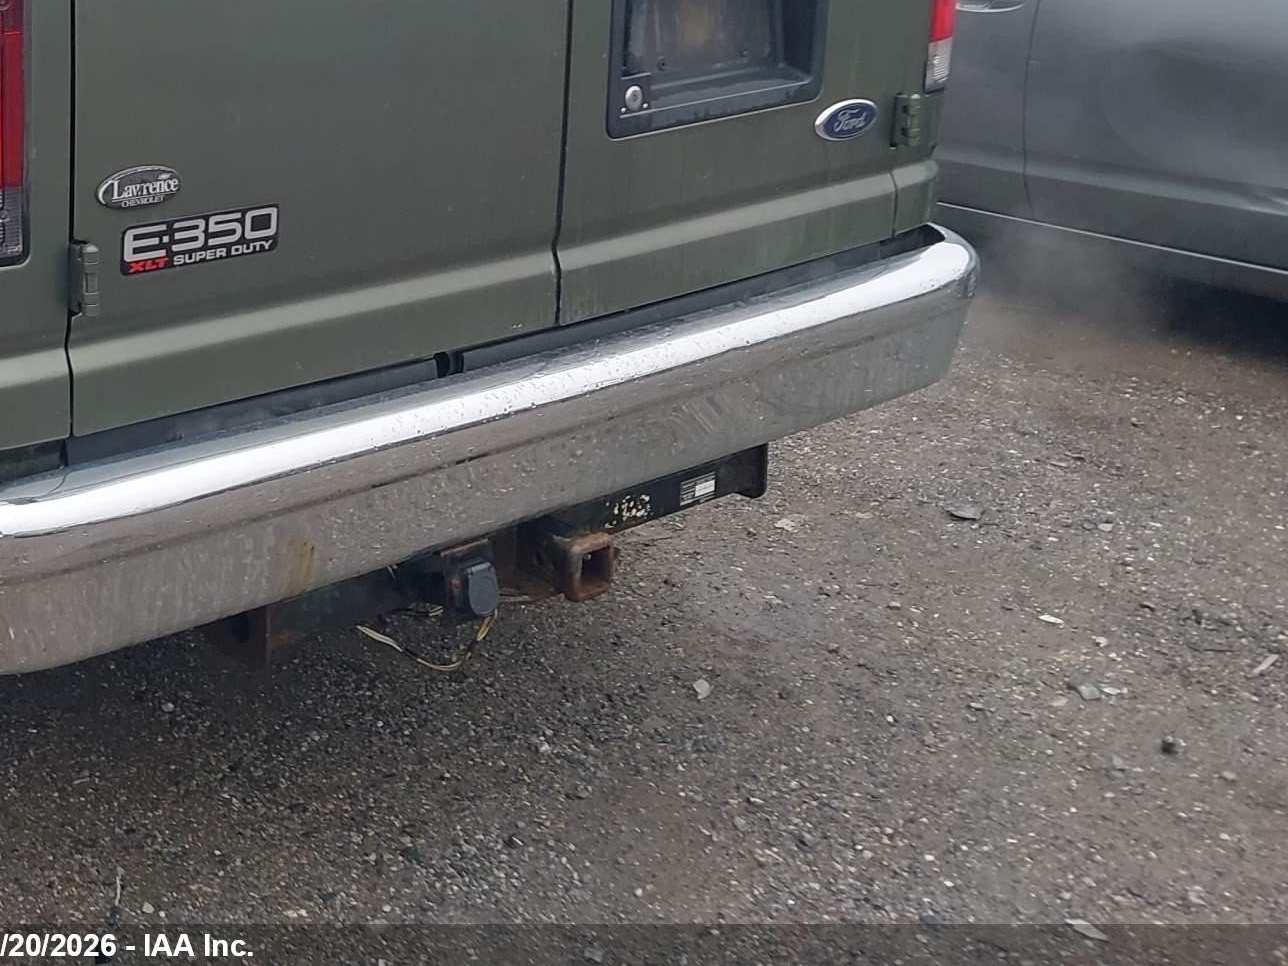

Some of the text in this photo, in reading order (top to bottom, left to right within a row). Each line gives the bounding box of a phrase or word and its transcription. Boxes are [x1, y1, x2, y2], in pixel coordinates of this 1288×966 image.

[111, 177, 179, 199] Lawrence
[120, 194, 165, 208] CHEVROLET
[173, 239, 274, 266] SUPER DUTY
[128, 256, 169, 273] XLT
